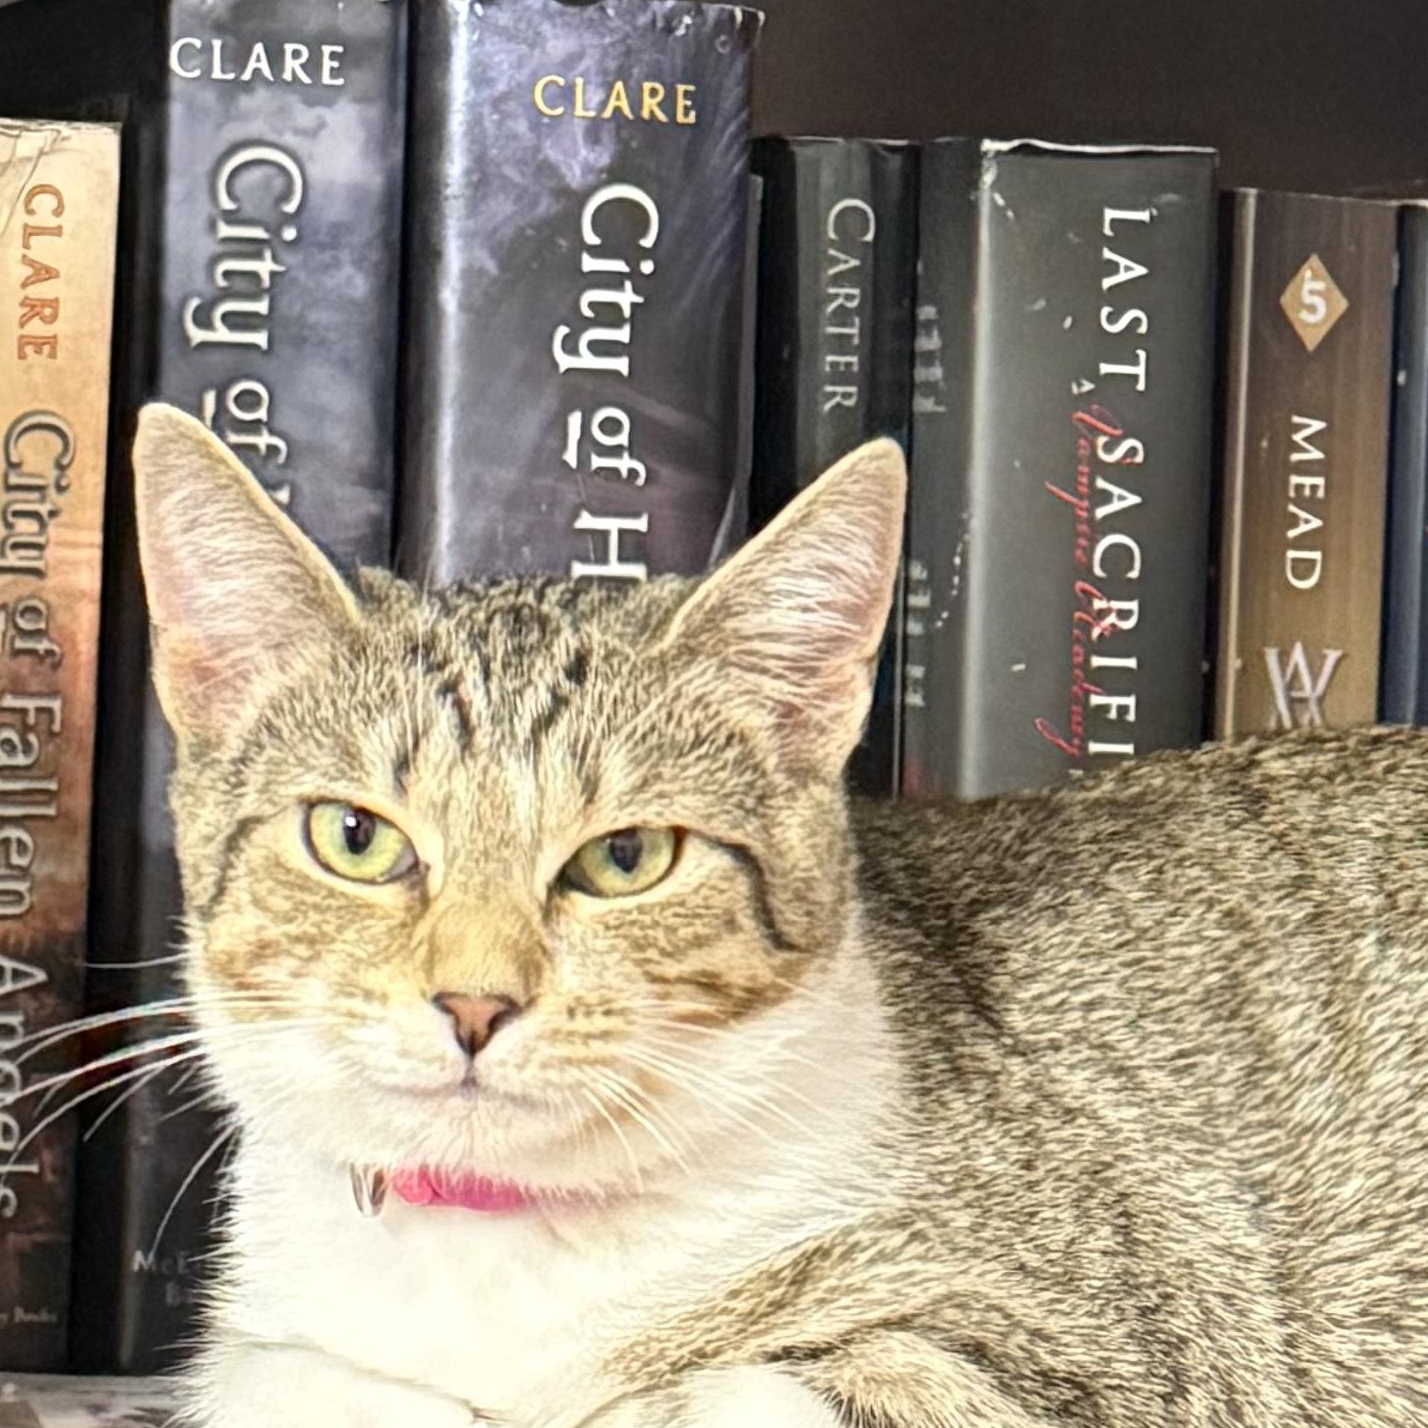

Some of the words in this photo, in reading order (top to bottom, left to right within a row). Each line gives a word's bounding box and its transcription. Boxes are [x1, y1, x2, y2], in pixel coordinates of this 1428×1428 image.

[168, 36, 347, 87] CLARE
[531, 74, 698, 126] CLARE
[15, 182, 67, 362] CLARE
[183, 142, 305, 353] City
[553, 183, 659, 378] City
[823, 198, 876, 414] CARTER
[1098, 206, 1152, 392] LAST
[1299, 278, 1326, 324] 5
[202, 380, 288, 464] of
[562, 405, 648, 488] of
[1285, 414, 1327, 591] MEAD
[1088, 436, 1144, 756] SACRIFI
